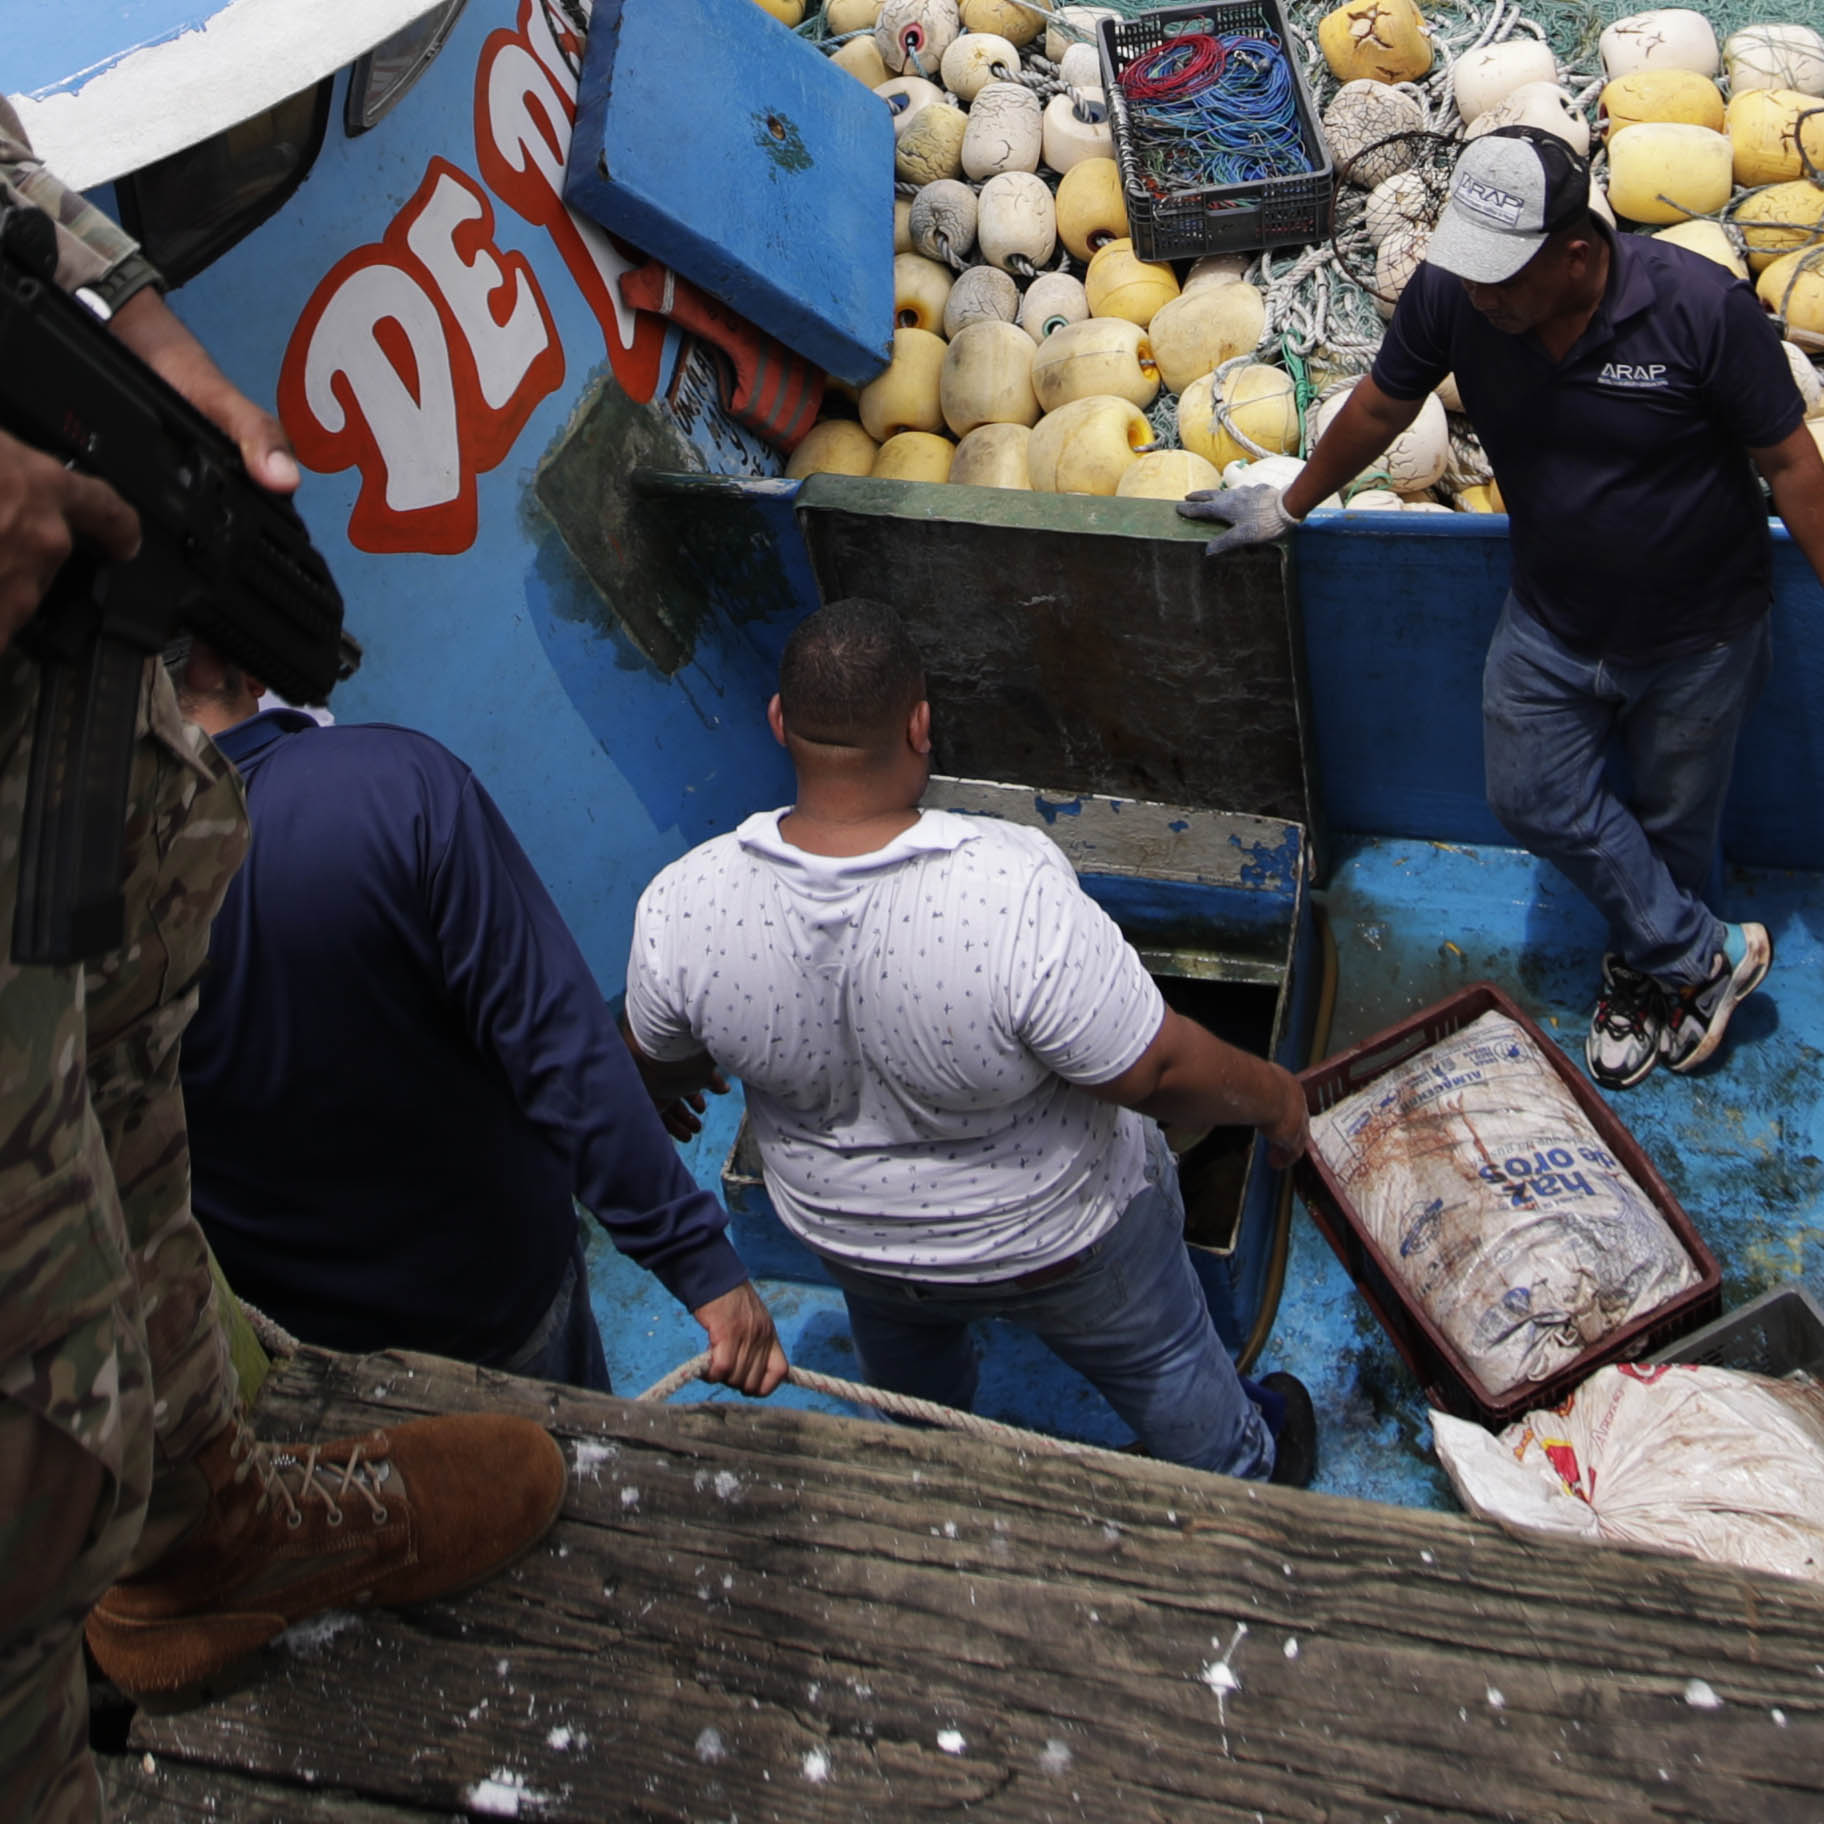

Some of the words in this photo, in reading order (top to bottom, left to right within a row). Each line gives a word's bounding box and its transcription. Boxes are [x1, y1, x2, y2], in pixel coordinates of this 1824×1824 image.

[1457, 174, 1525, 212] ARAP
[282, 158, 562, 544] DE
[1600, 362, 1667, 380] ARAP
[1502, 1171, 1596, 1208] haz
